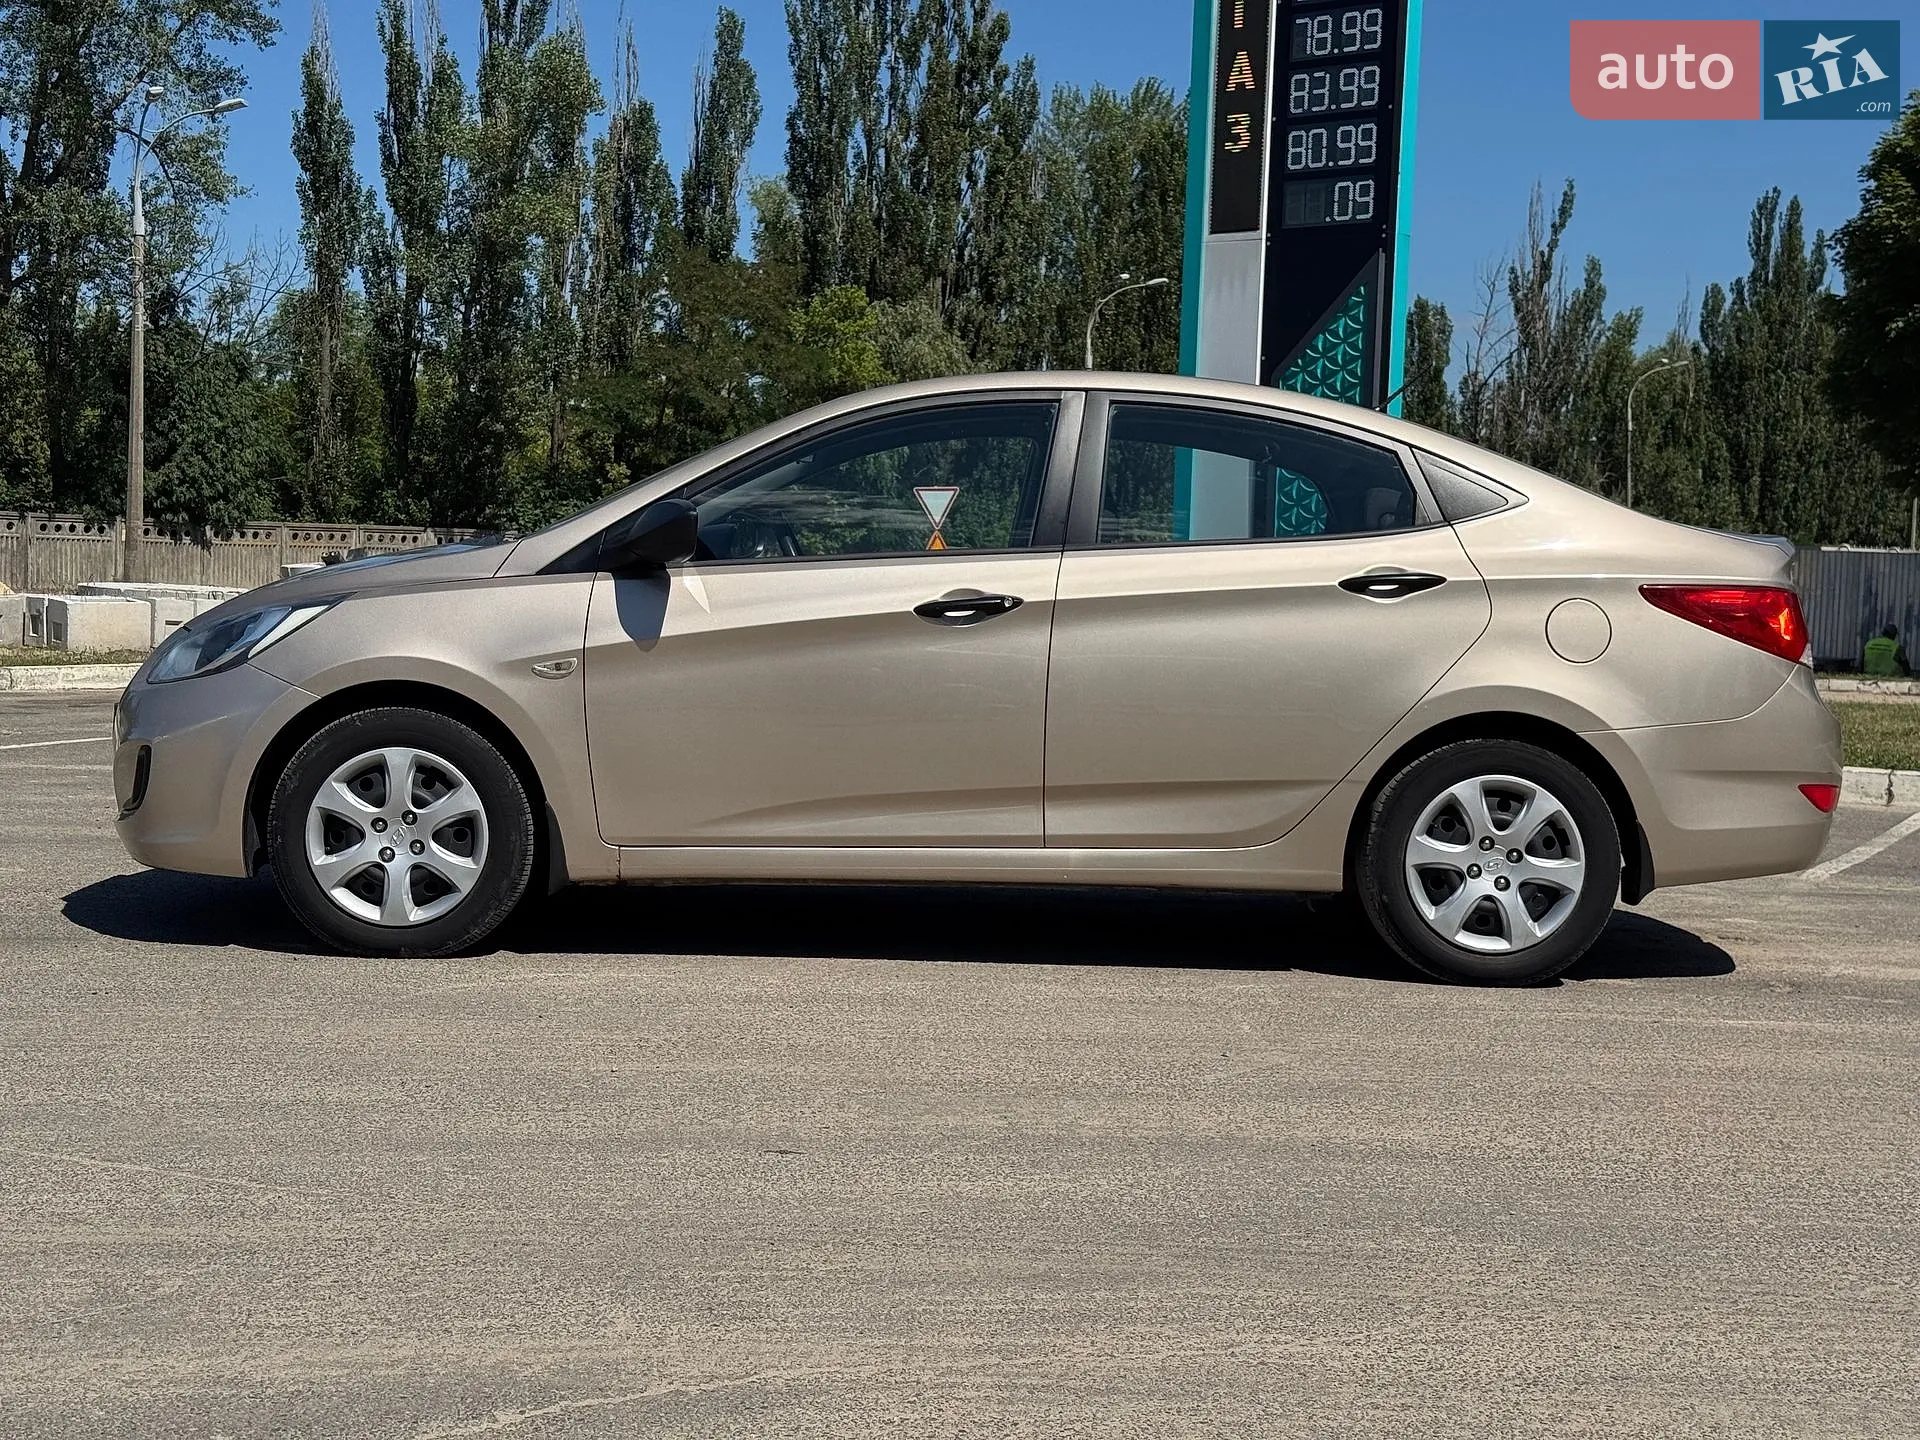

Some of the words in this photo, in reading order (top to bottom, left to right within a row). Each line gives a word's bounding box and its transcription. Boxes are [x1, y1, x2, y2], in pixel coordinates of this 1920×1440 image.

[1295, 8, 1383, 56] 78.99
[1289, 65, 1381, 114] 83.99
[1287, 122, 1378, 170] 80.99
[1325, 179, 1375, 222] .09
